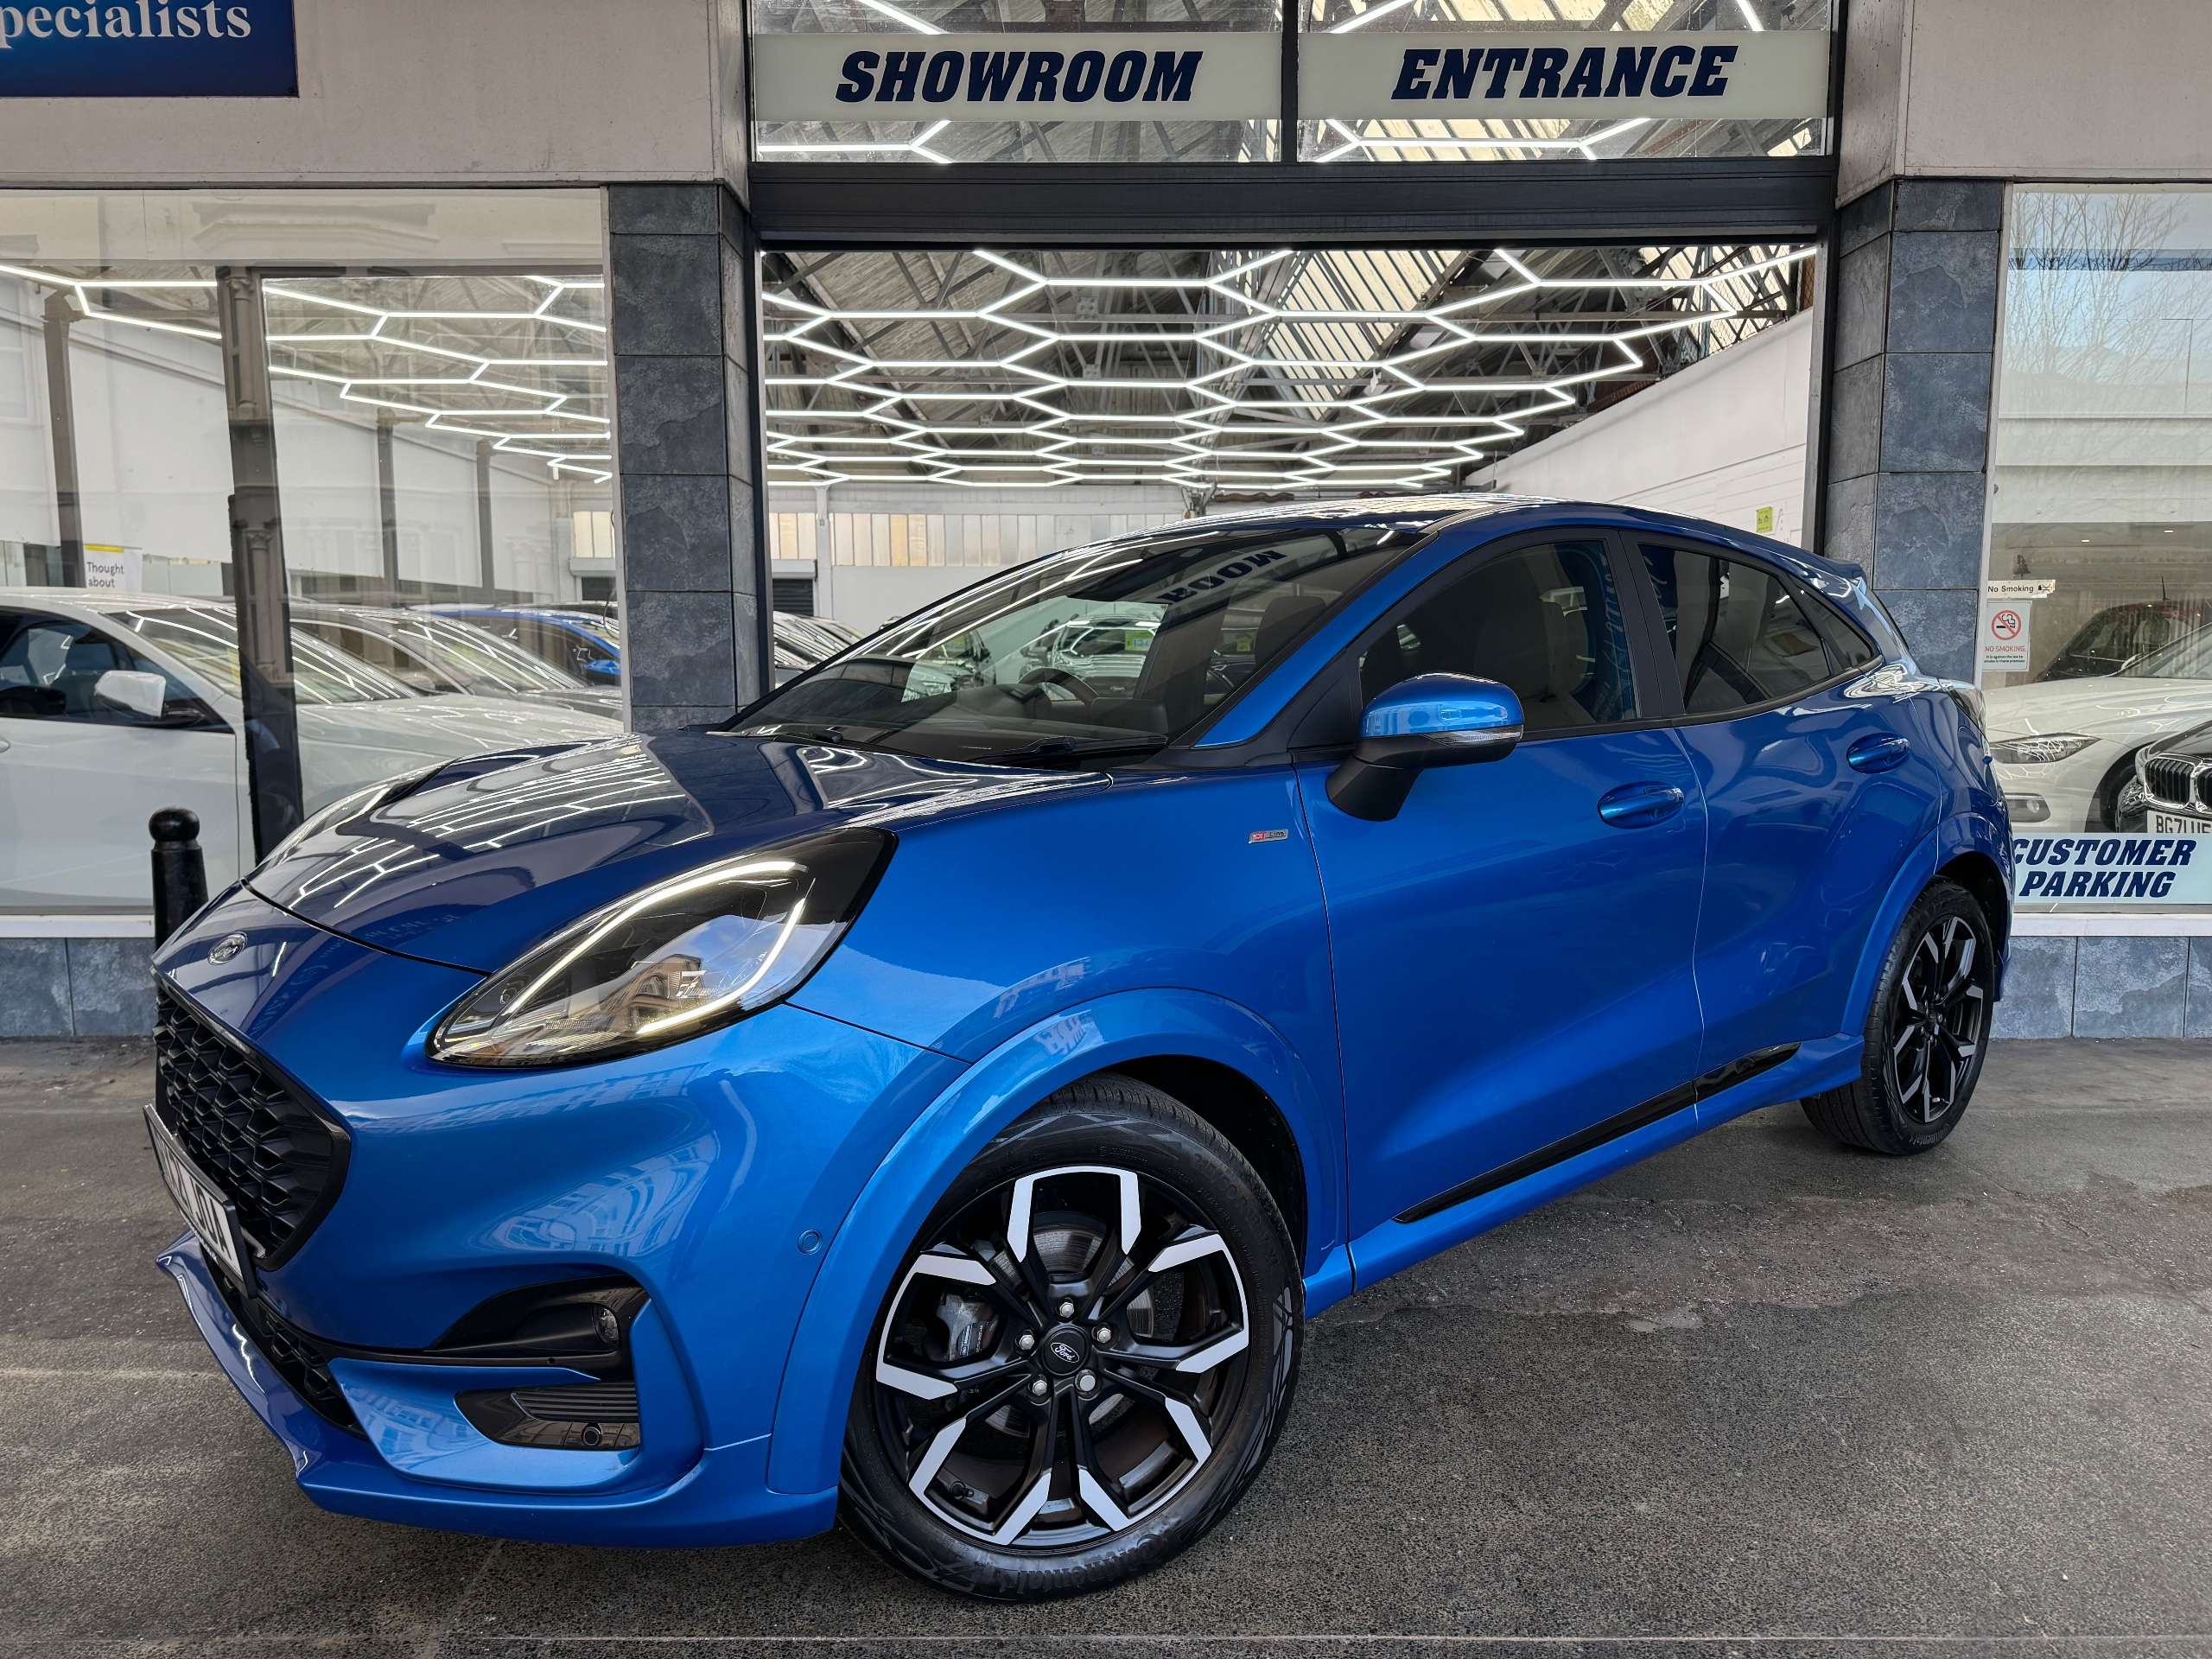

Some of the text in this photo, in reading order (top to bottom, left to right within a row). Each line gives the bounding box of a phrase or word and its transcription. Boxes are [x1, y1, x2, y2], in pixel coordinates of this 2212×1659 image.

[835, 45, 1738, 103] SHOWROOM ENTRANCE
[86, 562, 124, 576] Thought
[88, 576, 115, 588] about
[2001, 585, 2034, 594] Smoking
[2013, 838, 2197, 866] CUSTOMER
[2018, 871, 2177, 898] PARKING
[1054, 1344, 1076, 1361] Ford
